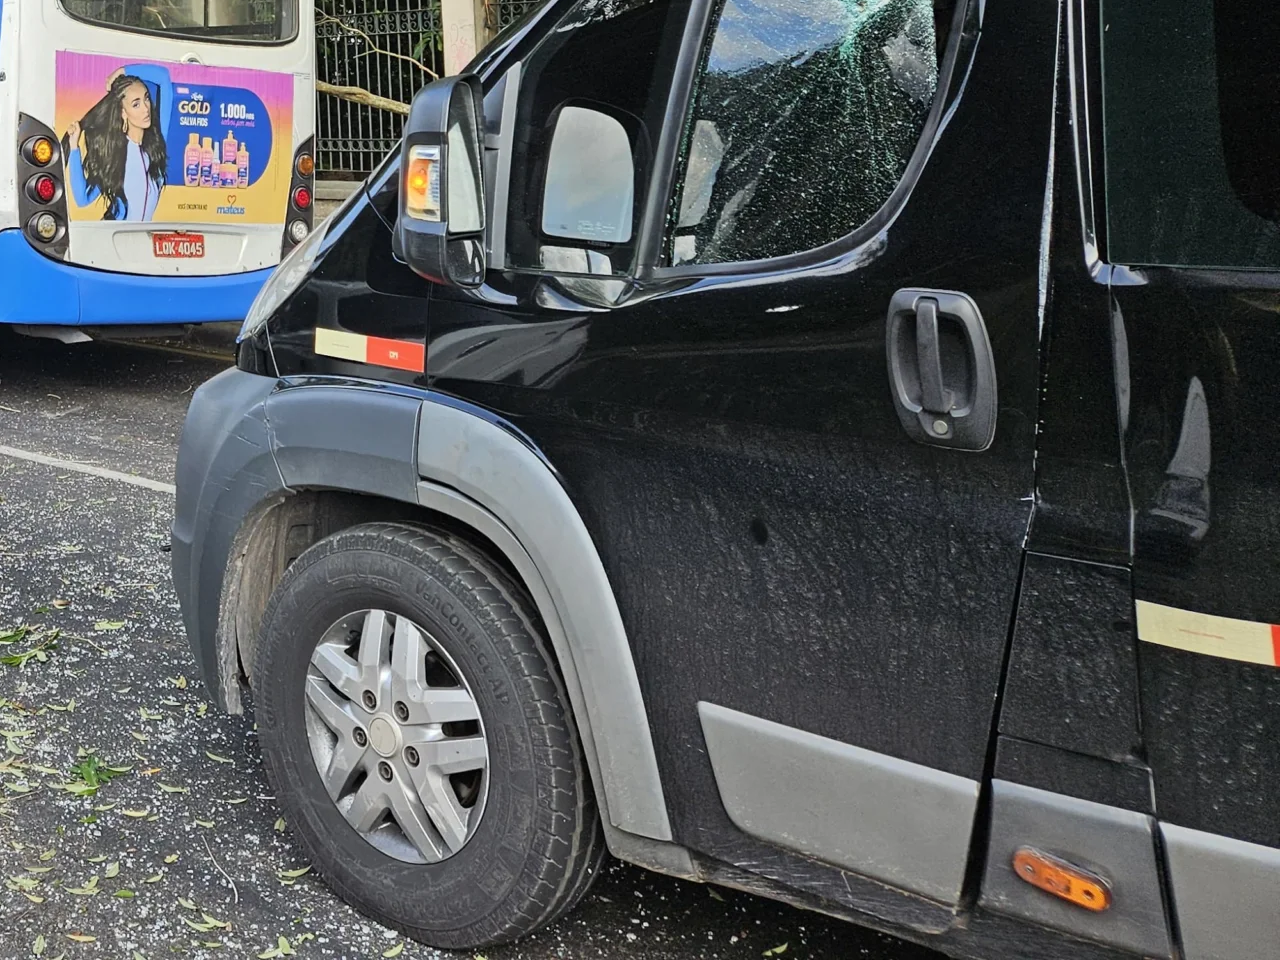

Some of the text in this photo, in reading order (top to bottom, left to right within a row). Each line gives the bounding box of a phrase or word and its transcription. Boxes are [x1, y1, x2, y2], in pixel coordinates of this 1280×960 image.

[178, 100, 211, 115] GOLD
[219, 103, 246, 119] 1.000
[217, 205, 245, 214] mateus
